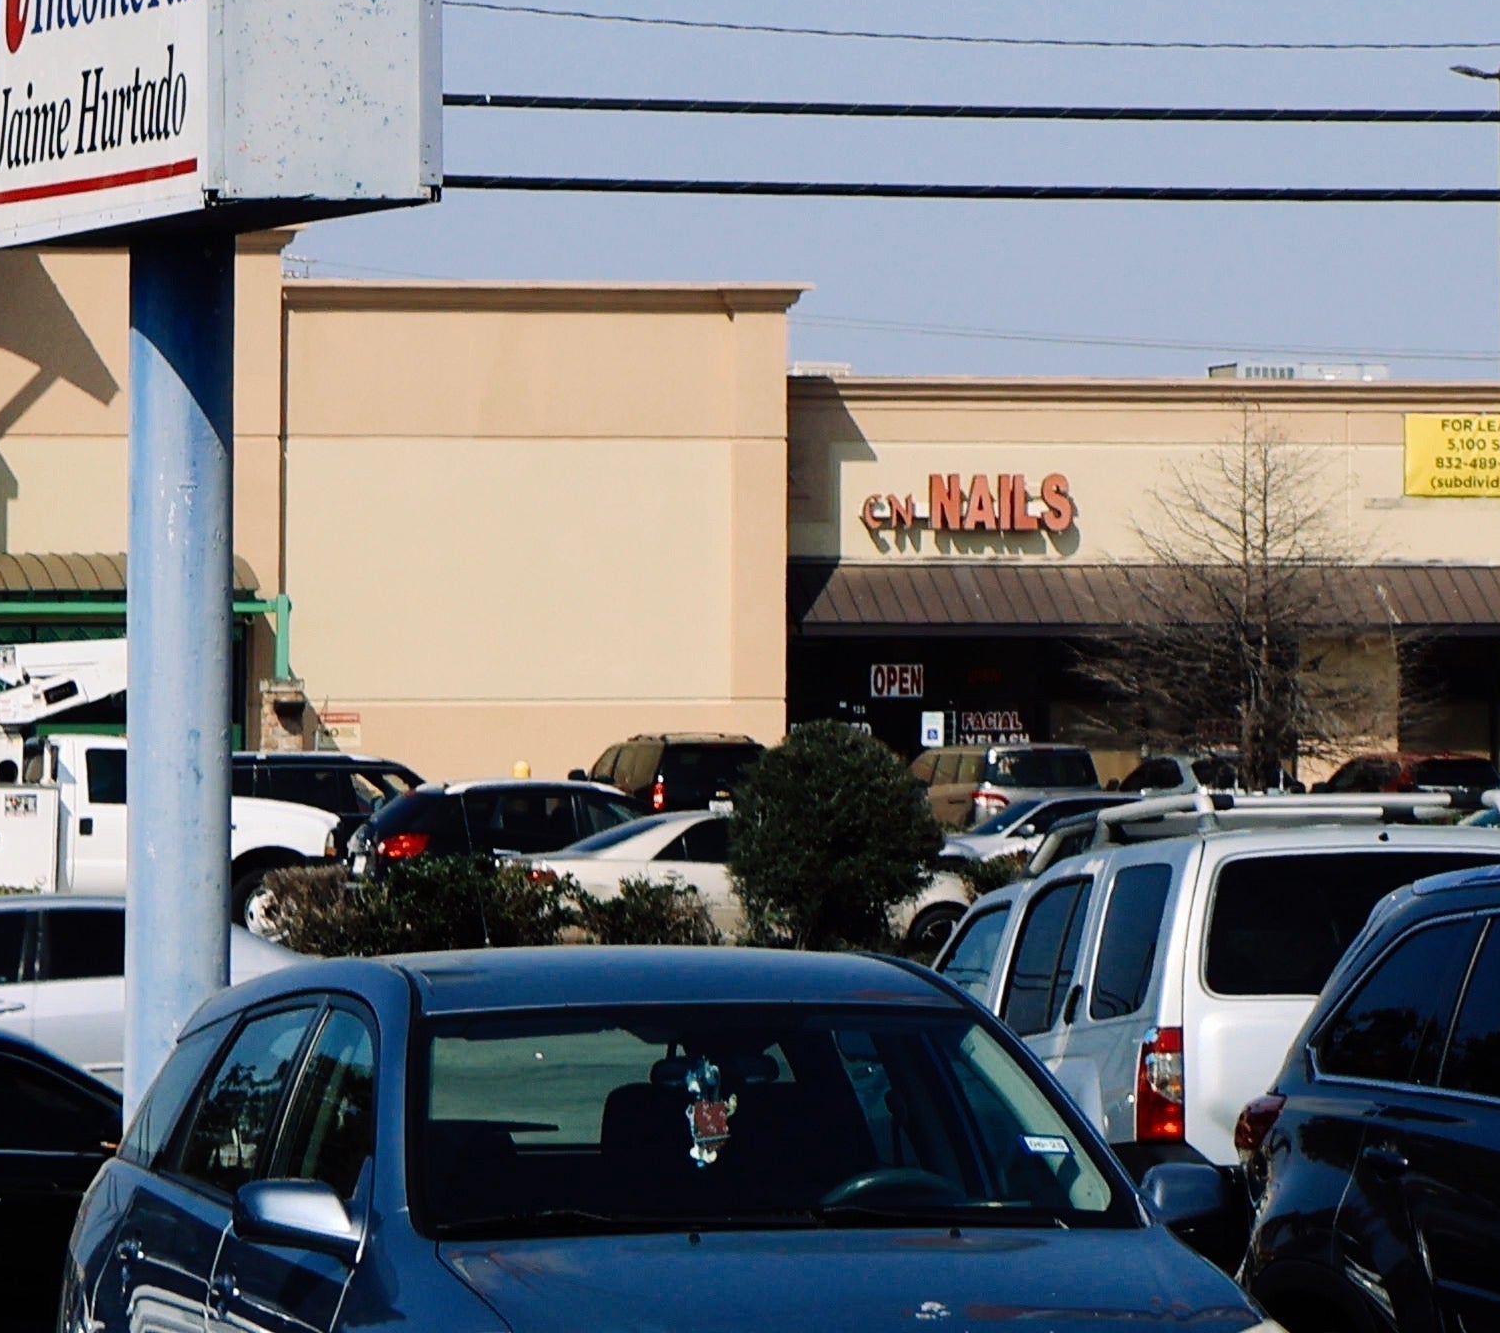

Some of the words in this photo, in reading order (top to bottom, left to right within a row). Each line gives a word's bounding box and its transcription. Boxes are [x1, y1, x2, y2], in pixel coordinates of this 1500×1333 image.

[74, 44, 187, 155] Hurtado
[1441, 419, 1473, 432] FOR
[1447, 438, 1487, 452] 5,100
[862, 493, 914, 530] CN
[928, 472, 1074, 532] NAILS
[873, 665, 923, 696] OPEN
[962, 711, 1023, 731] FACIAL
